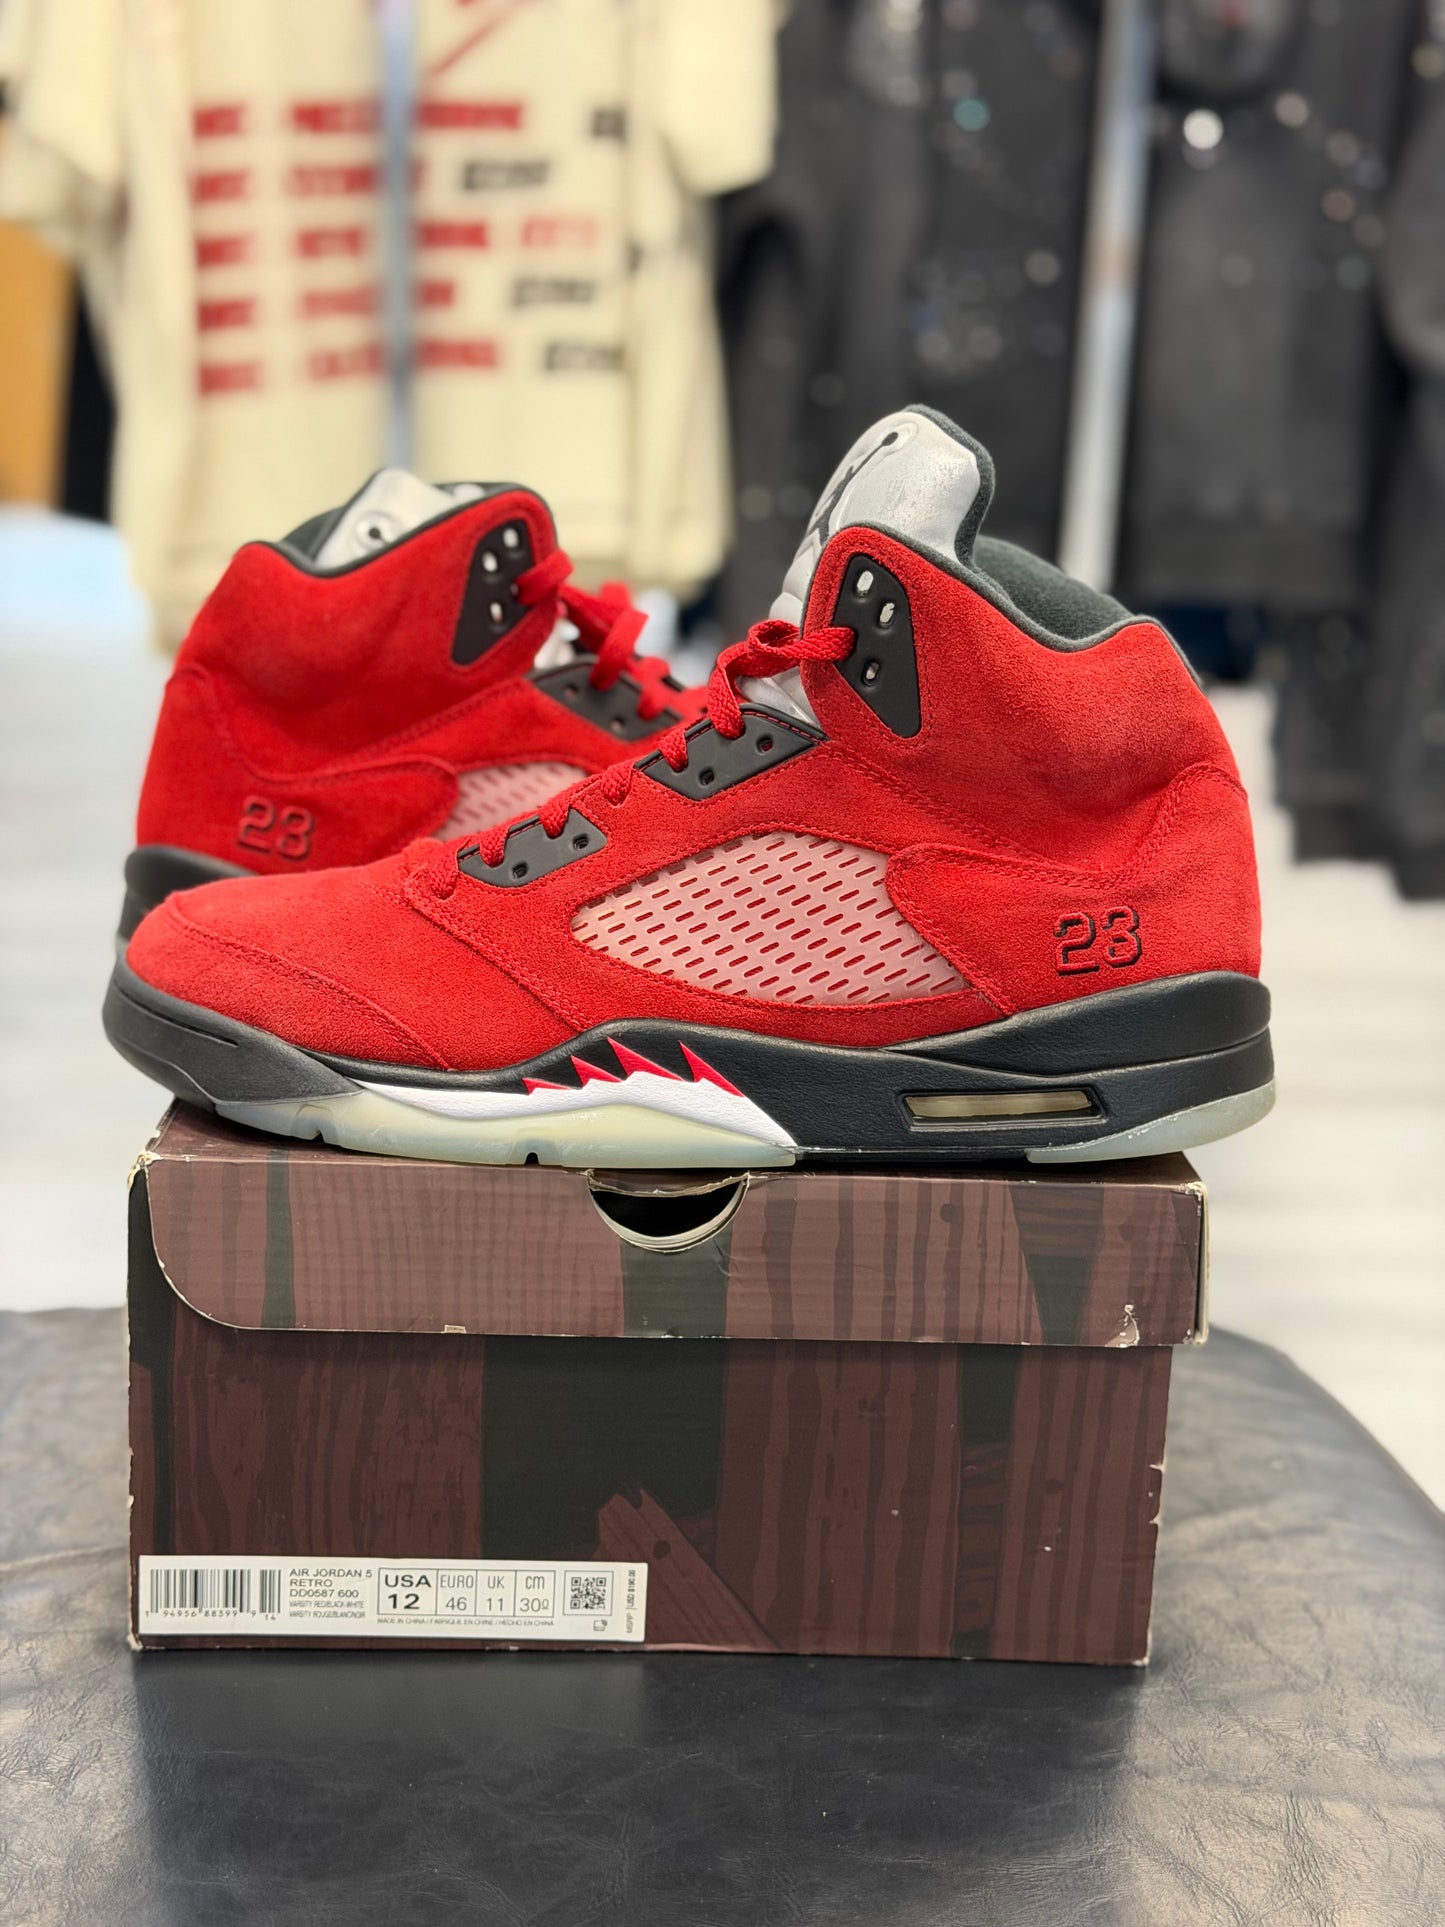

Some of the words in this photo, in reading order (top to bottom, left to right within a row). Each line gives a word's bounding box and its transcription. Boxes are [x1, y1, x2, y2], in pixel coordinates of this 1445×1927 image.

[237, 795, 315, 862] 23
[1053, 905, 1142, 976] 23
[289, 1568, 310, 1577] AIR
[313, 1568, 362, 1577] JORDAN
[366, 1569, 373, 1578] 5
[289, 1578, 333, 1587] RETRO
[384, 1574, 432, 1589] USA
[440, 1574, 474, 1588] EURO
[487, 1575, 505, 1589] UK
[525, 1575, 545, 1590] cm
[289, 1588, 335, 1598] DD0587
[337, 1589, 359, 1598] 600
[387, 1593, 420, 1610] 12
[445, 1596, 467, 1611] 46
[486, 1598, 503, 1612] 11
